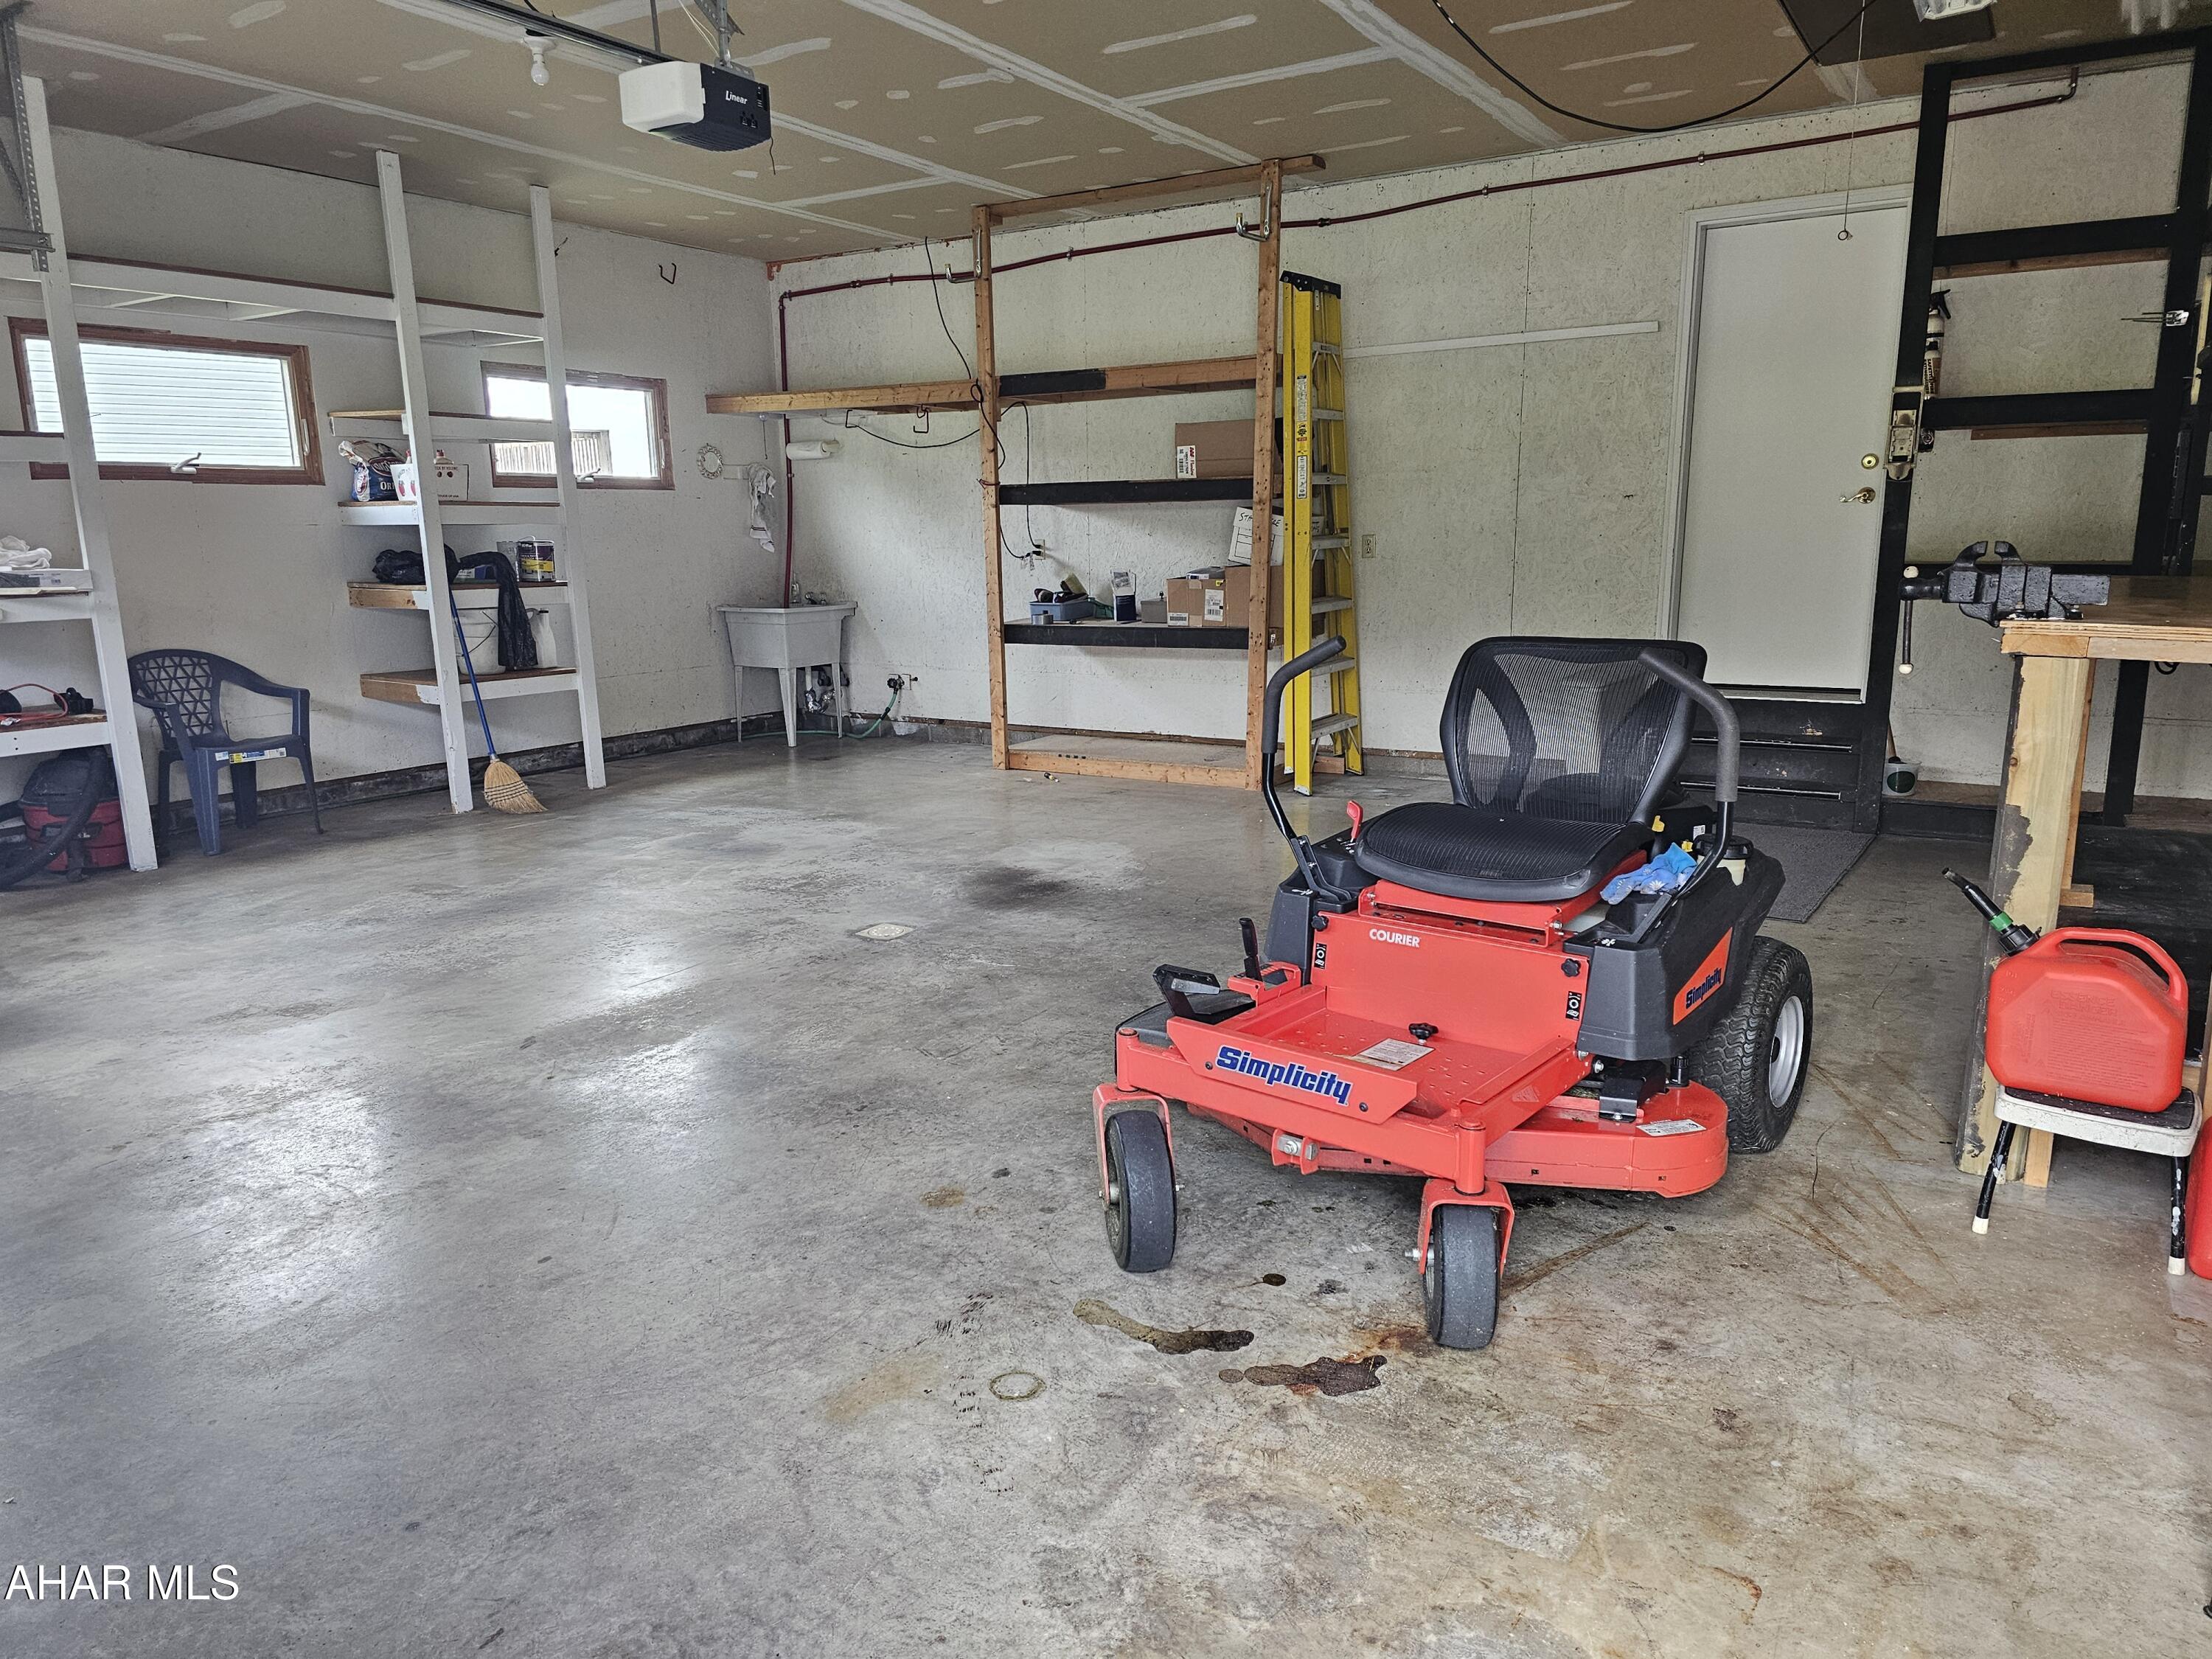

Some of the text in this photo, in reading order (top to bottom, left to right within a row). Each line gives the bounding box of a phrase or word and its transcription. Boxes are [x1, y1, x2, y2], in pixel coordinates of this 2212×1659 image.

[726, 89, 748, 105] Linear
[1369, 928, 1420, 948] COURIER
[1686, 967, 1722, 1009] Simplicity
[1216, 1045, 1353, 1106] Simplicity
